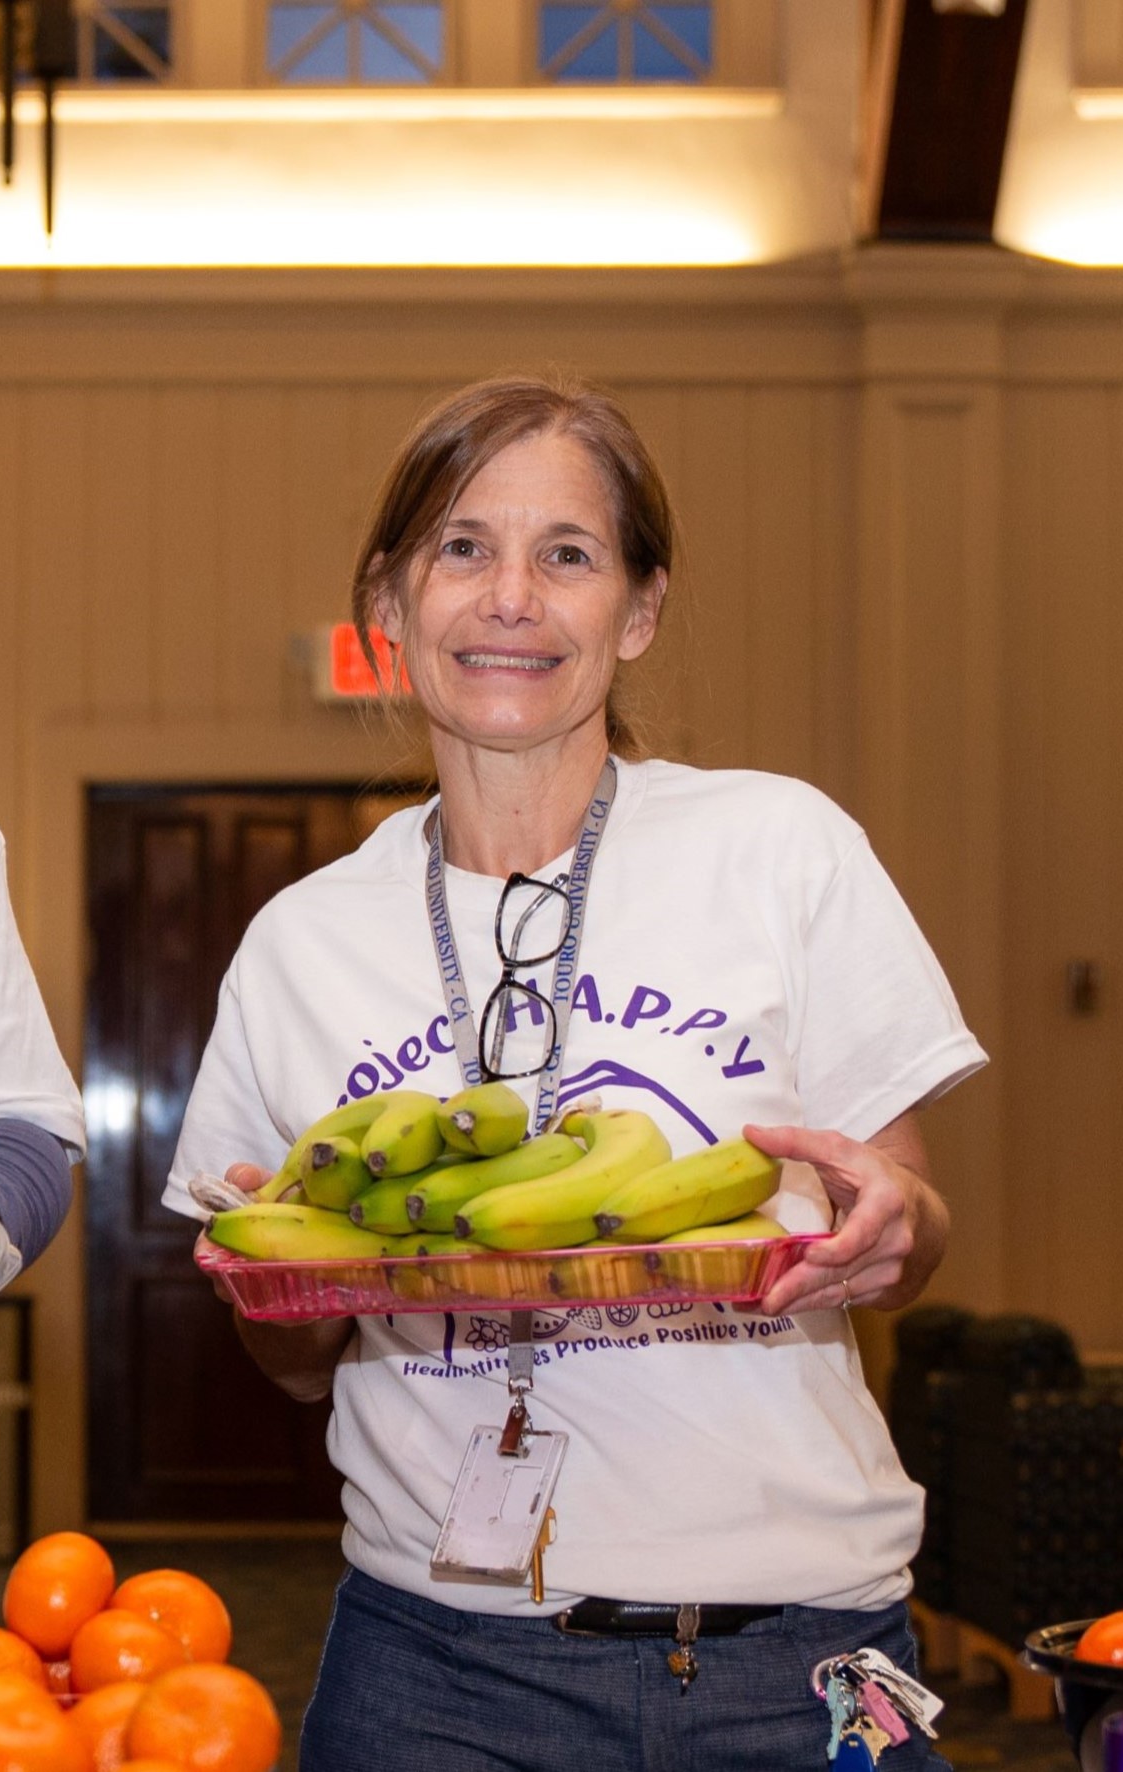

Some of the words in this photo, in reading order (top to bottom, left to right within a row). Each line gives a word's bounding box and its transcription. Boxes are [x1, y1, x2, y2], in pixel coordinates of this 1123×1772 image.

[428, 880, 461, 983] UNIVERSITY
[449, 996, 468, 1024] CA
[552, 934, 578, 1006] TOURO
[565, 827, 600, 929] UNIVERSITY
[589, 798, 610, 820] CA
[335, 1013, 459, 1109] ojec
[555, 1333, 650, 1358] Produce
[656, 1321, 738, 1343] Positive
